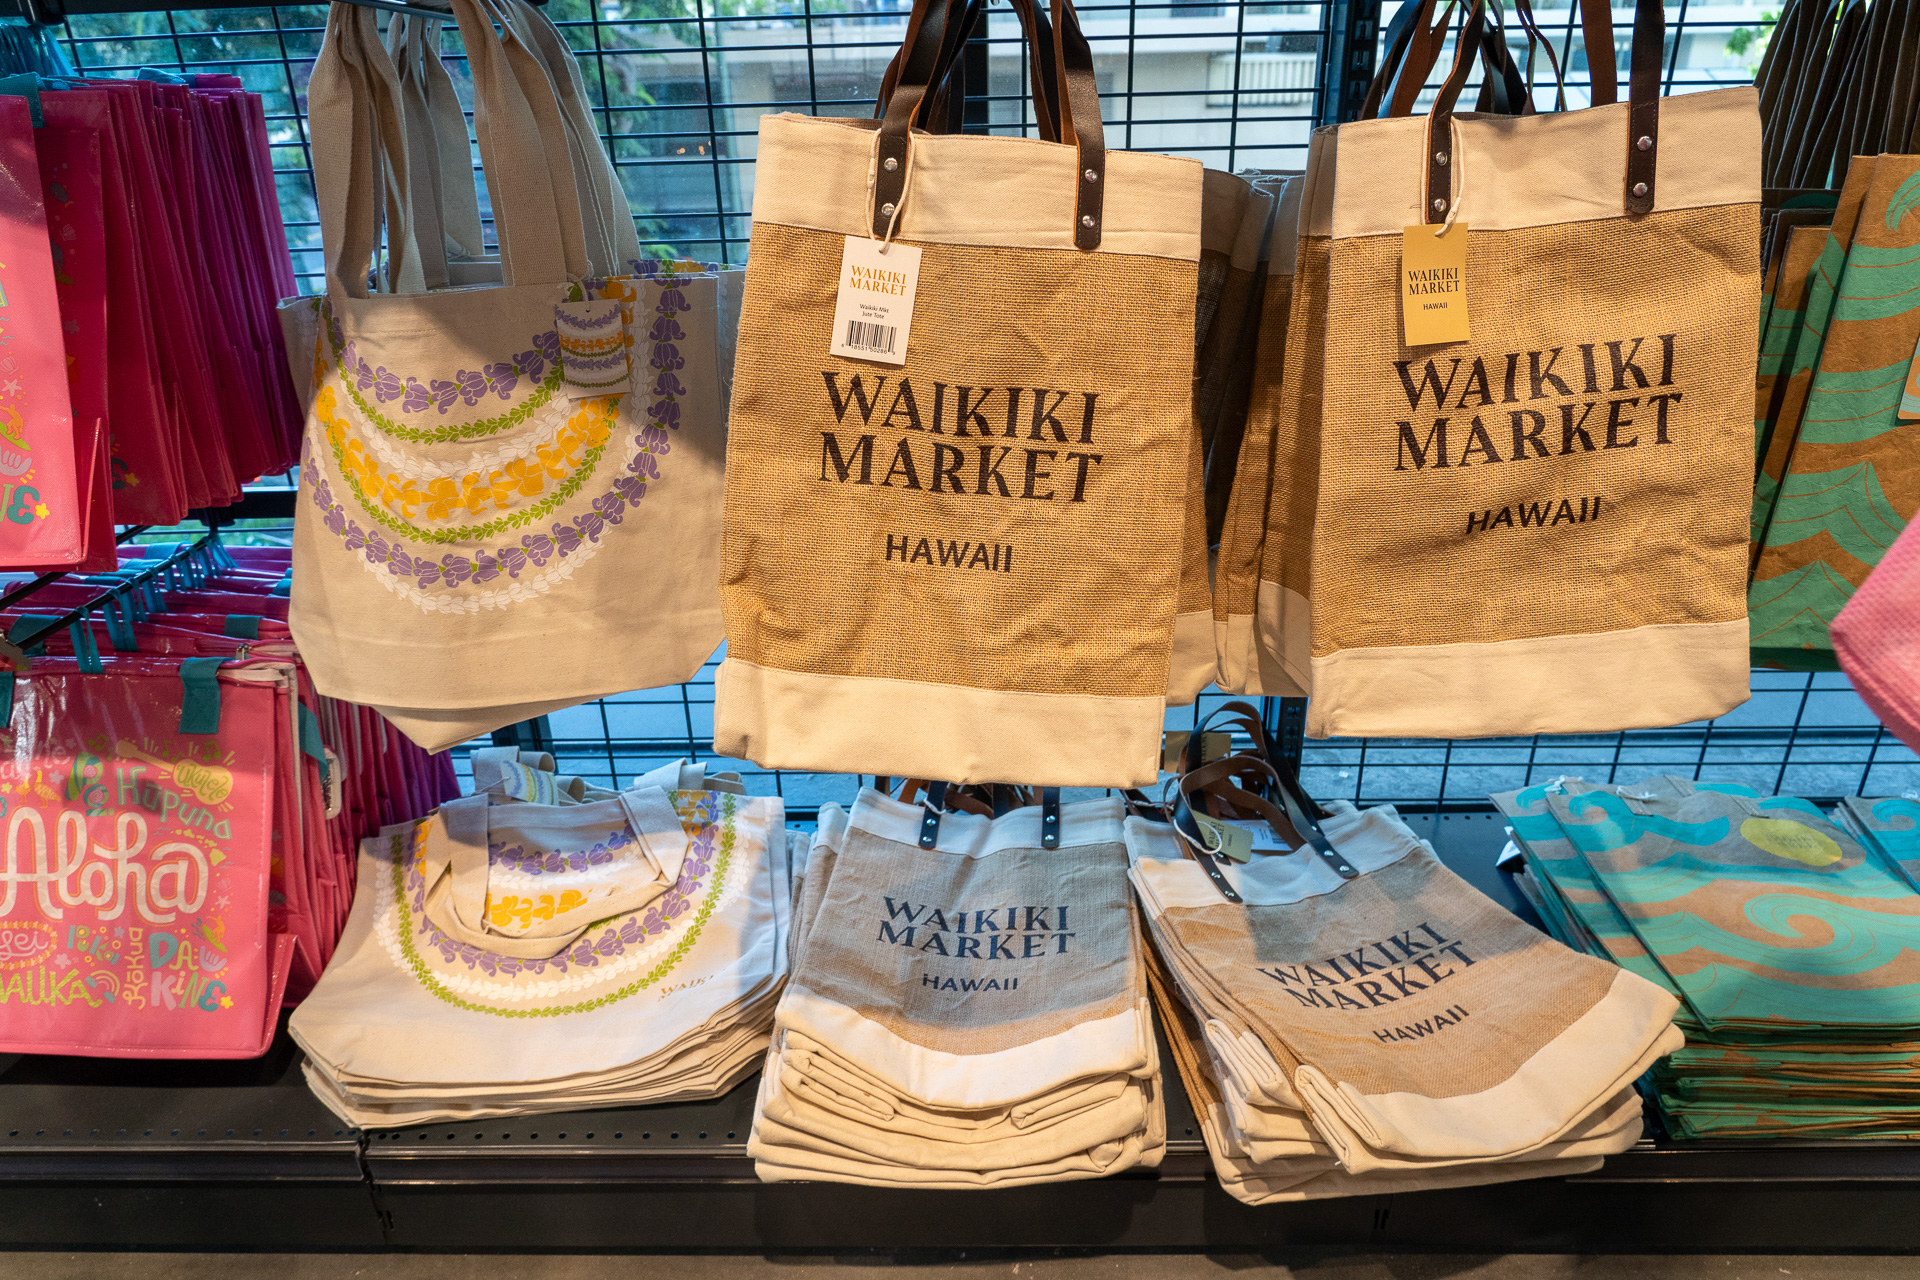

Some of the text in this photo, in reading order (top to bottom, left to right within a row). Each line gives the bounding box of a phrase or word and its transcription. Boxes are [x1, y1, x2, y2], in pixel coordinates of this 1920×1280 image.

[849, 277, 907, 296] MARKET
[851, 265, 907, 285] WAIKIKI
[1408, 267, 1459, 282] WAIKIKI
[1409, 280, 1460, 295] MARKET
[860, 303, 878, 312] Waikiki
[1423, 302, 1448, 310] HAWAII
[1393, 333, 1677, 412] WAIKIKI
[821, 371, 1100, 444] WAIKIKI
[1393, 392, 1683, 471] MARKET
[817, 432, 1103, 502] MARKET
[1465, 497, 1602, 534] HAWAII
[885, 534, 1012, 573] HAWAII
[0, 806, 209, 924] Aloha
[883, 896, 1069, 934] WAIKIKI
[876, 920, 1076, 961] MARKET
[1256, 922, 1448, 986] WAIKIKI
[922, 973, 1018, 992] HAWAII
[1282, 940, 1477, 1010] MARKET
[1373, 1004, 1470, 1043] HAWAII
